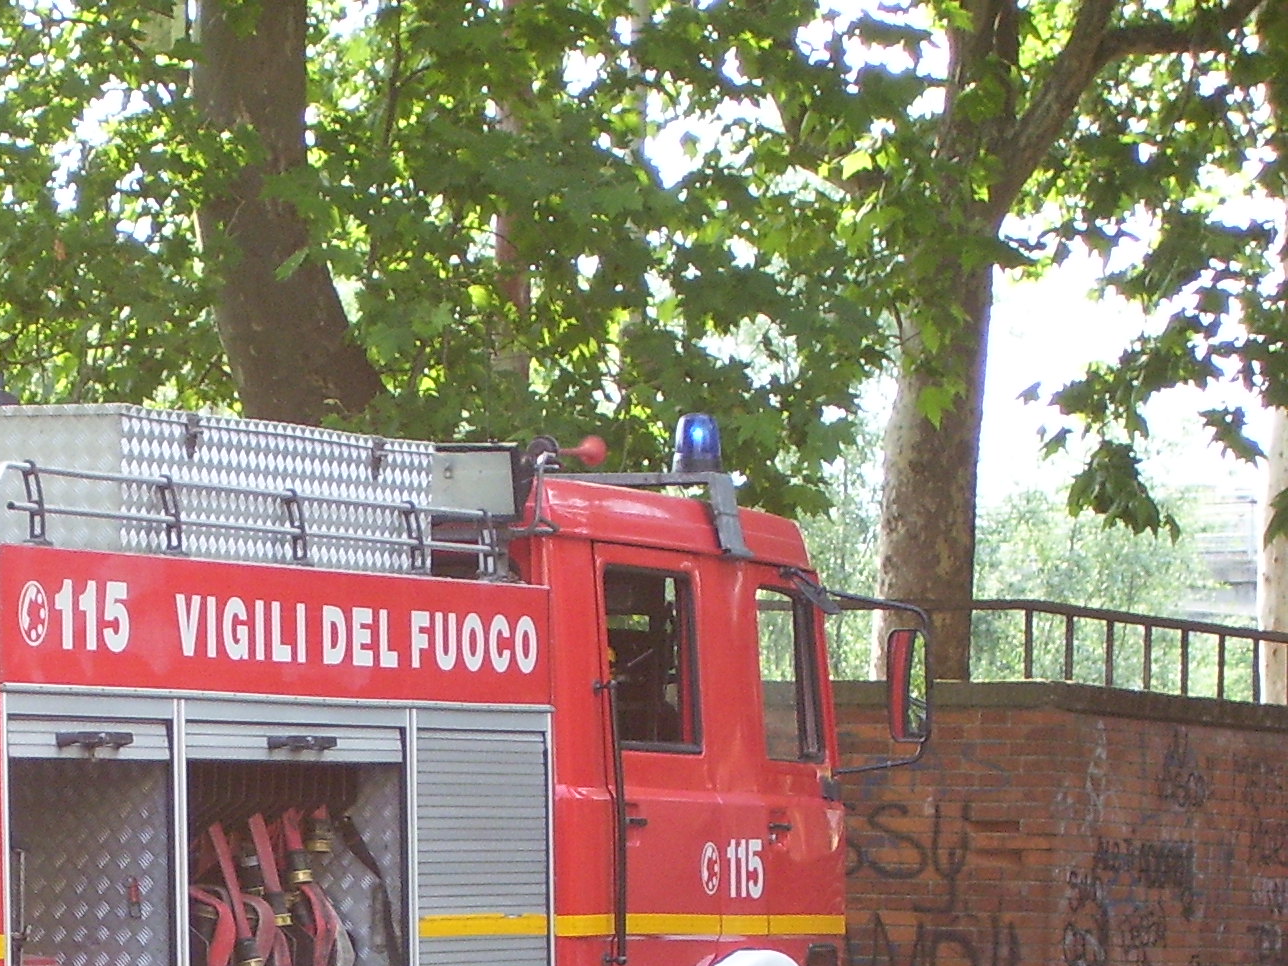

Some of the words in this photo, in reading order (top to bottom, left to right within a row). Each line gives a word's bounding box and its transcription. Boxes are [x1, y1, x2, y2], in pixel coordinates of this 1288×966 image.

[53, 578, 130, 653] 115
[174, 592, 306, 663] VIGILI
[322, 604, 398, 668] DEL
[410, 609, 538, 675] FUOCO
[726, 838, 764, 899] 115
